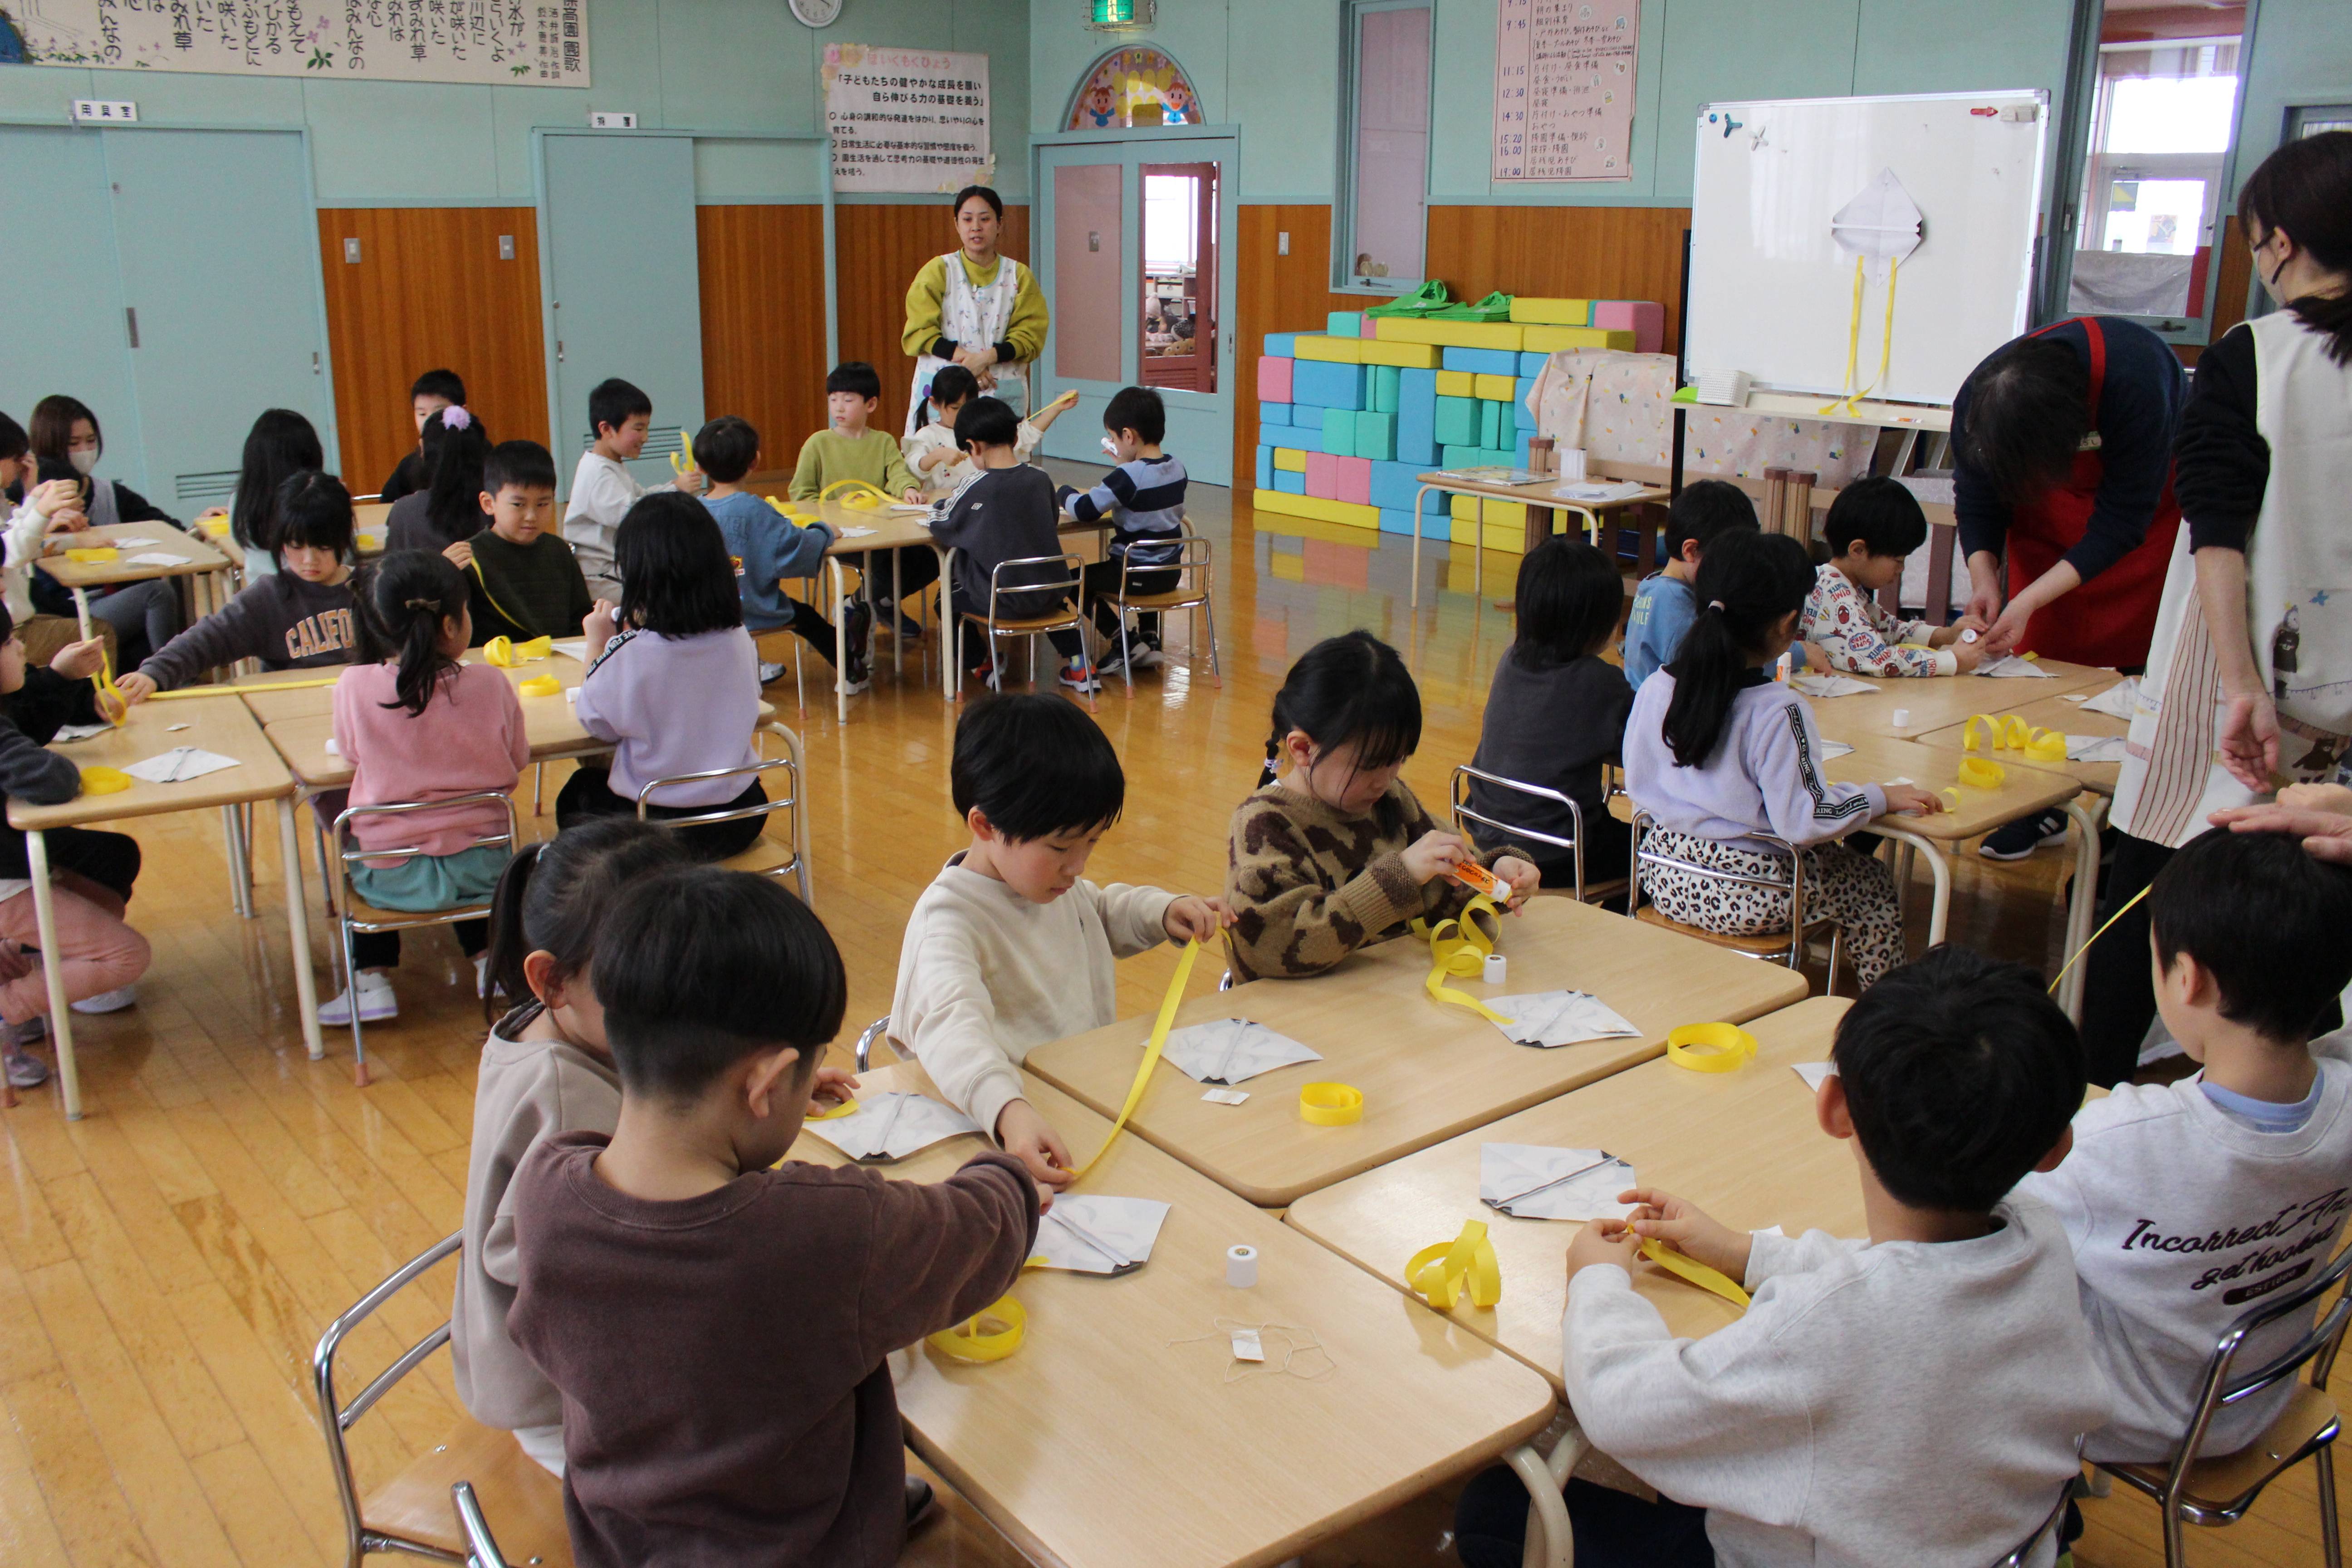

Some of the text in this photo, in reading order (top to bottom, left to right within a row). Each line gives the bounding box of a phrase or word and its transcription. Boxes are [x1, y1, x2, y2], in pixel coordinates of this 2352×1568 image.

[218, 0, 238, 49] 咲いた
[242, 0, 261, 66] ふもとに
[264, 0, 282, 54] ひかる
[429, 0, 446, 44] 咲いた
[489, 0, 505, 62] らいくよ
[867, 53, 951, 69] ほいくもくひょう
[1503, 65, 1525, 76] 11:15
[1503, 88, 1524, 98] 12:30
[1502, 111, 1524, 122] 14:30
[1532, 122, 1556, 131] おやつ
[1500, 167, 1521, 177] 19:00
[285, 608, 355, 659] CALIFO
[2122, 1203, 2298, 1254] Incorrect
[2191, 1251, 2259, 1290] get
